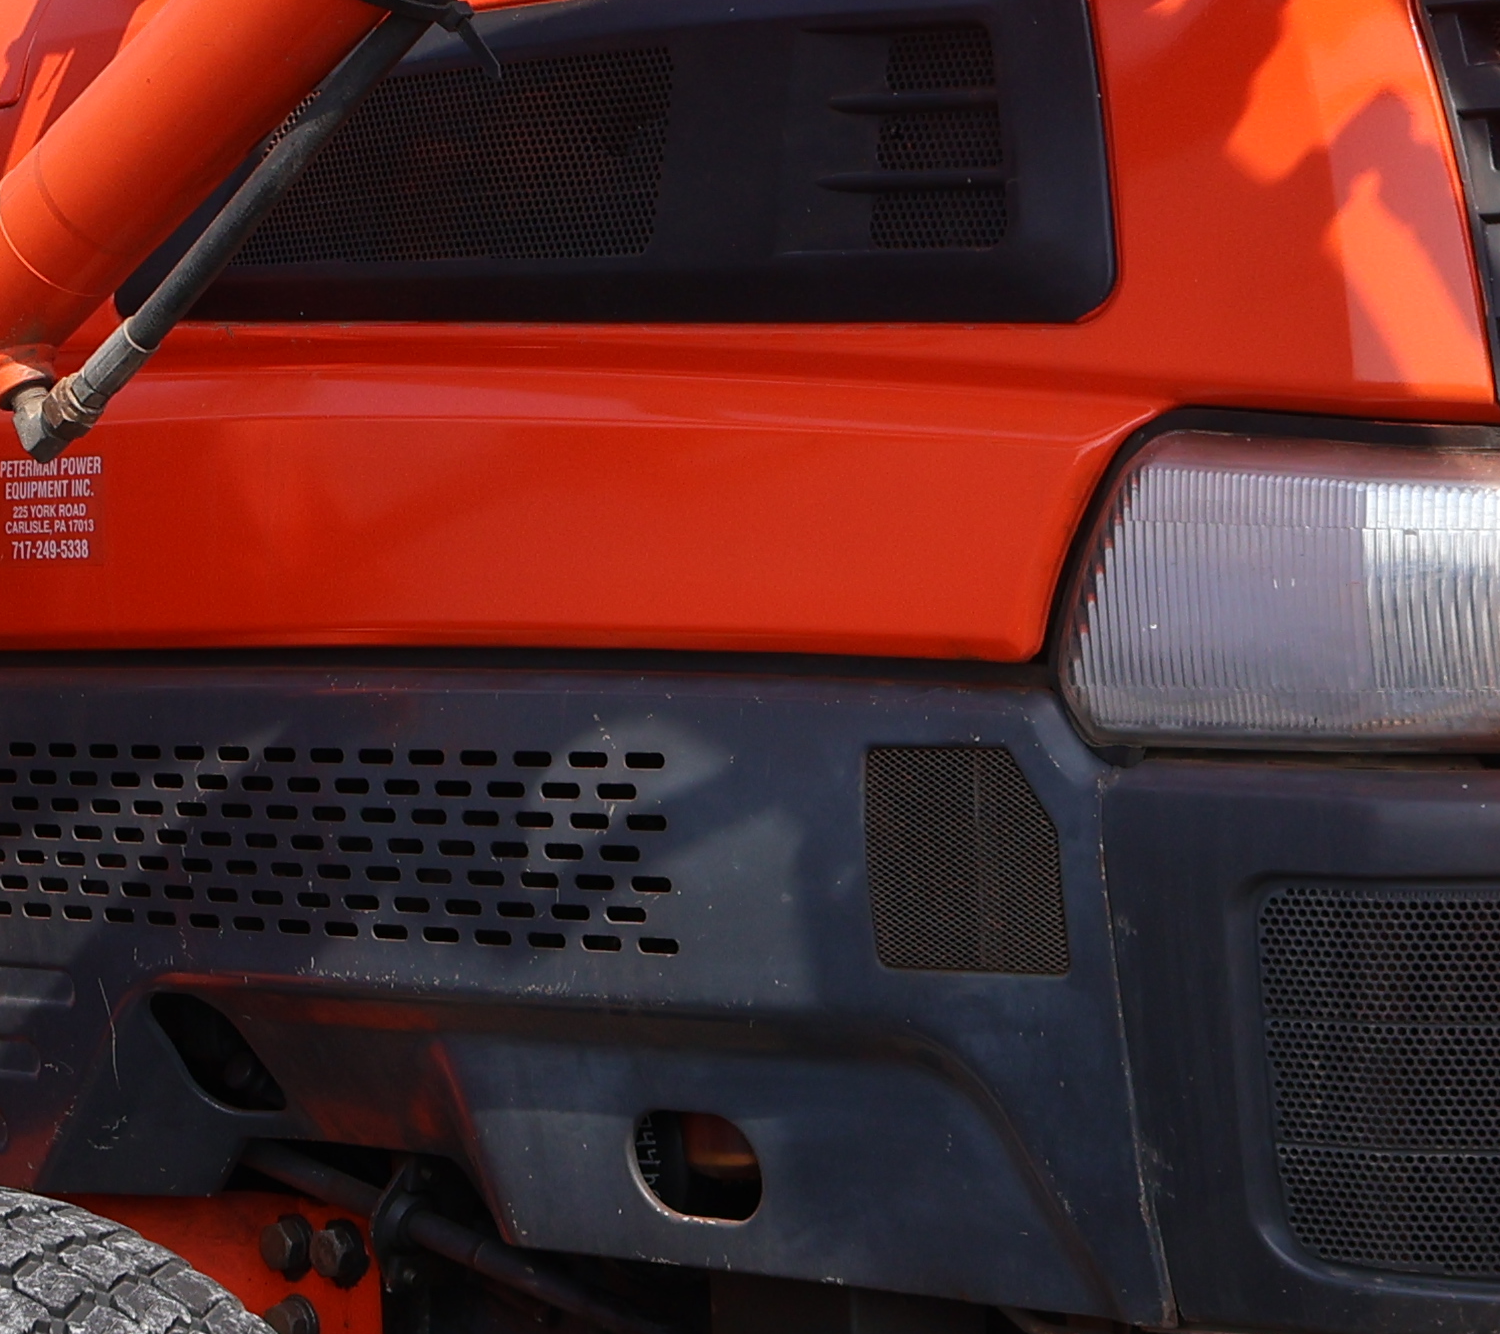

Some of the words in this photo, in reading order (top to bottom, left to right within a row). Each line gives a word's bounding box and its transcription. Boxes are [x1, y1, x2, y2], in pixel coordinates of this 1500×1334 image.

[0, 458, 58, 478] PETERMAN
[60, 456, 101, 475] POWER
[5, 480, 68, 500] EQUIPMENT
[71, 479, 94, 497] INC.
[12, 506, 29, 519] 225
[30, 505, 56, 518] YORK
[58, 503, 86, 517] ROAD
[5, 521, 52, 535] CARLISLE,
[54, 520, 67, 532] PA
[68, 519, 95, 532] 17013
[12, 539, 89, 559] 717-249-5338
